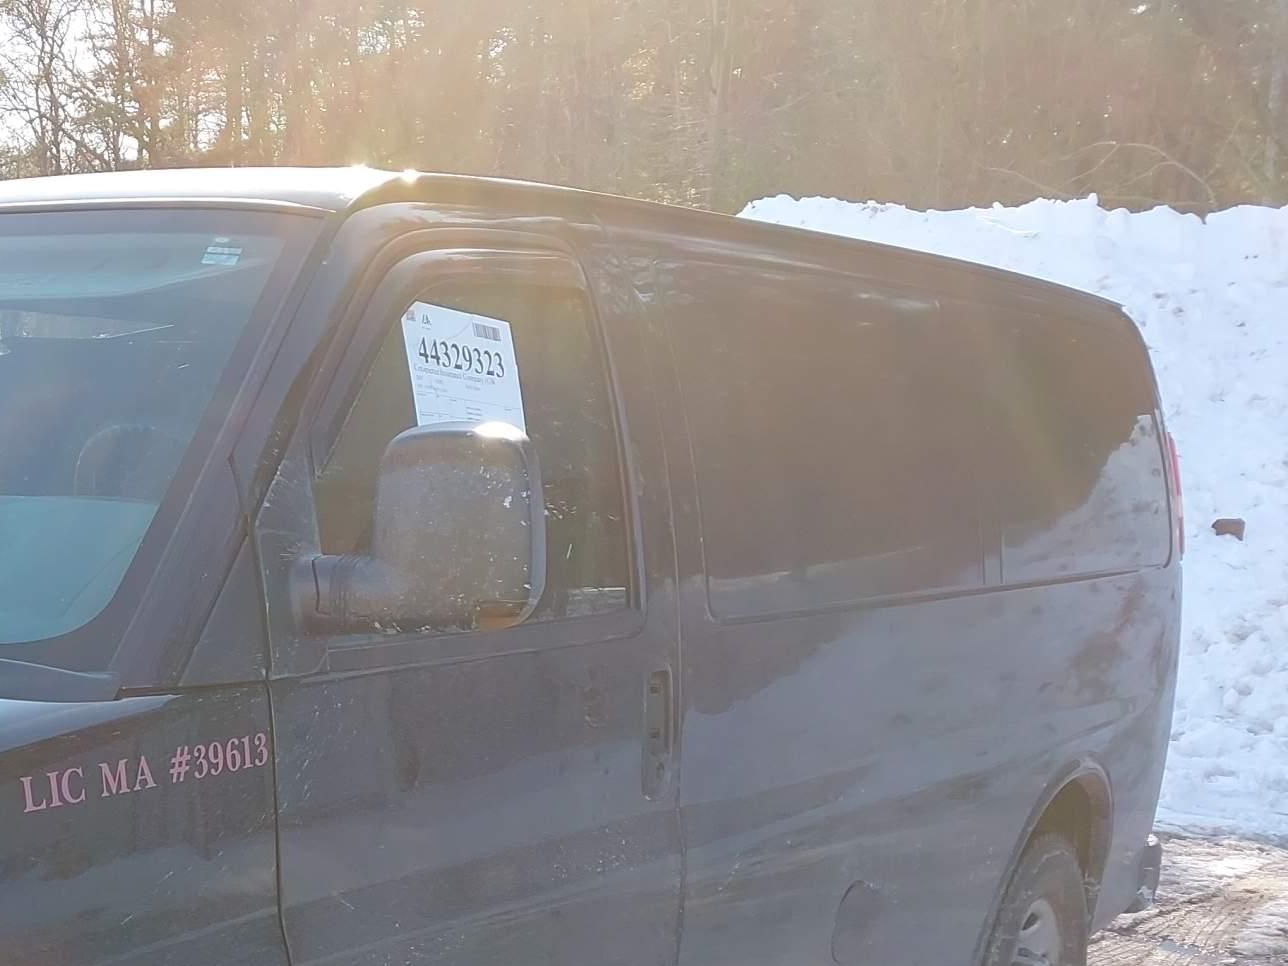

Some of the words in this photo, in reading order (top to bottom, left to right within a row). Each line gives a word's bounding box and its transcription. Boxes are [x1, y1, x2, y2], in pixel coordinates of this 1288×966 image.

[418, 336, 505, 378] 44329323
[20, 767, 86, 813] LIC
[98, 755, 157, 797] MA
[169, 732, 270, 784] #39613
